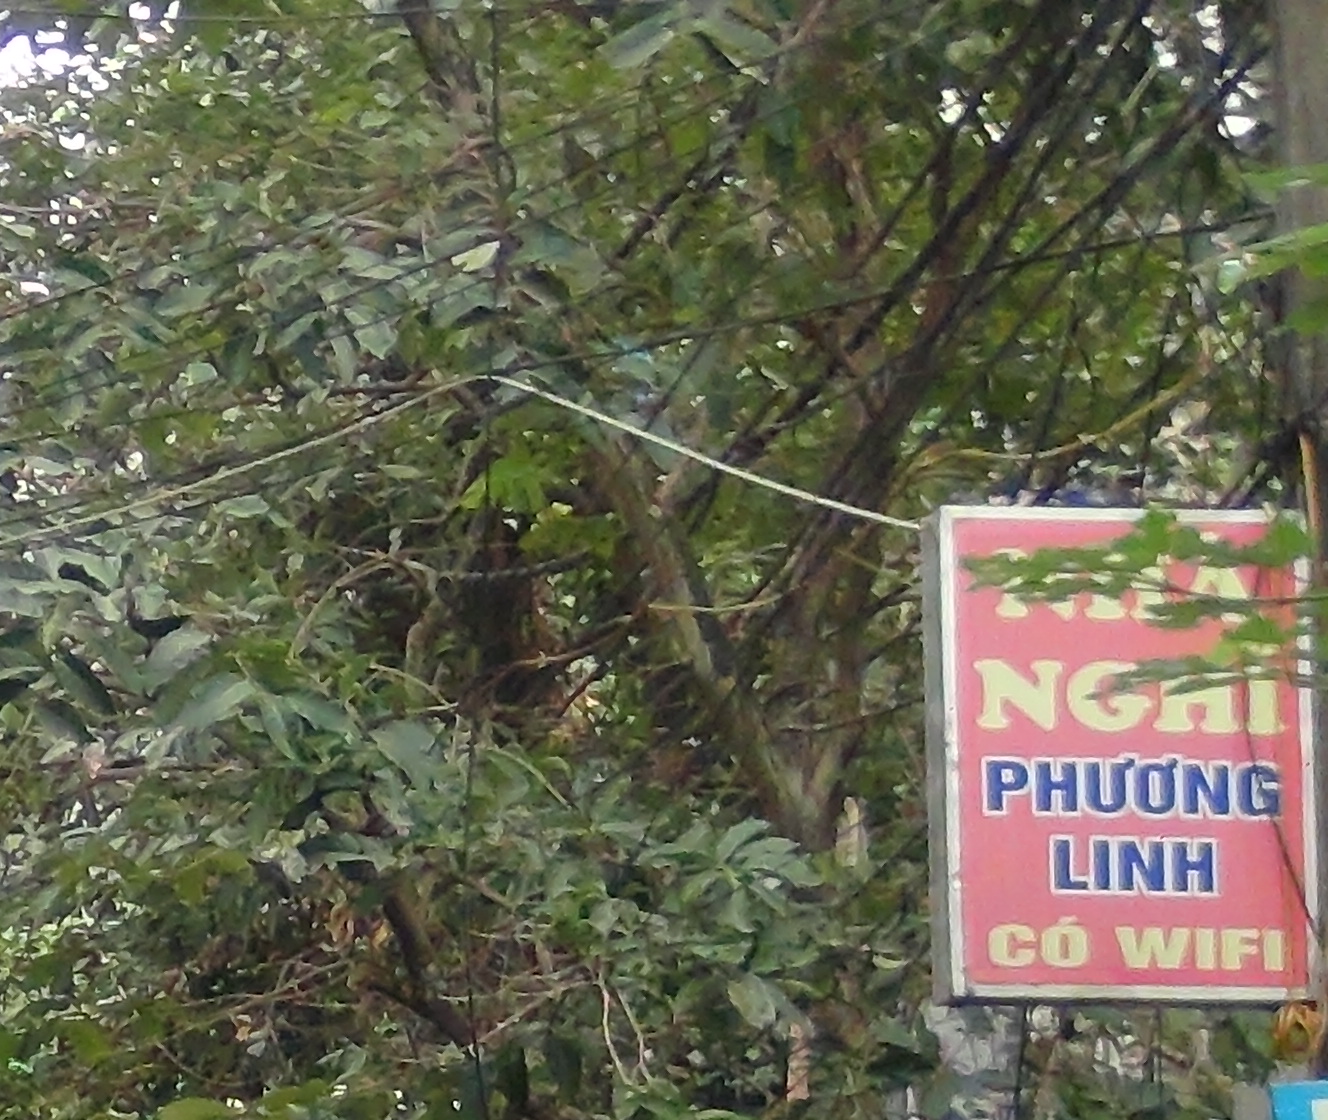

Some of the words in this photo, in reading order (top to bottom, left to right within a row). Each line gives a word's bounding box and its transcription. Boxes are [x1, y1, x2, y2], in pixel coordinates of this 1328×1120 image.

[985, 757, 1283, 818] PHƯƠNG
[1051, 836, 1219, 894] LINH
[987, 916, 1090, 969] CÓ
[1115, 925, 1287, 972] WIFI
